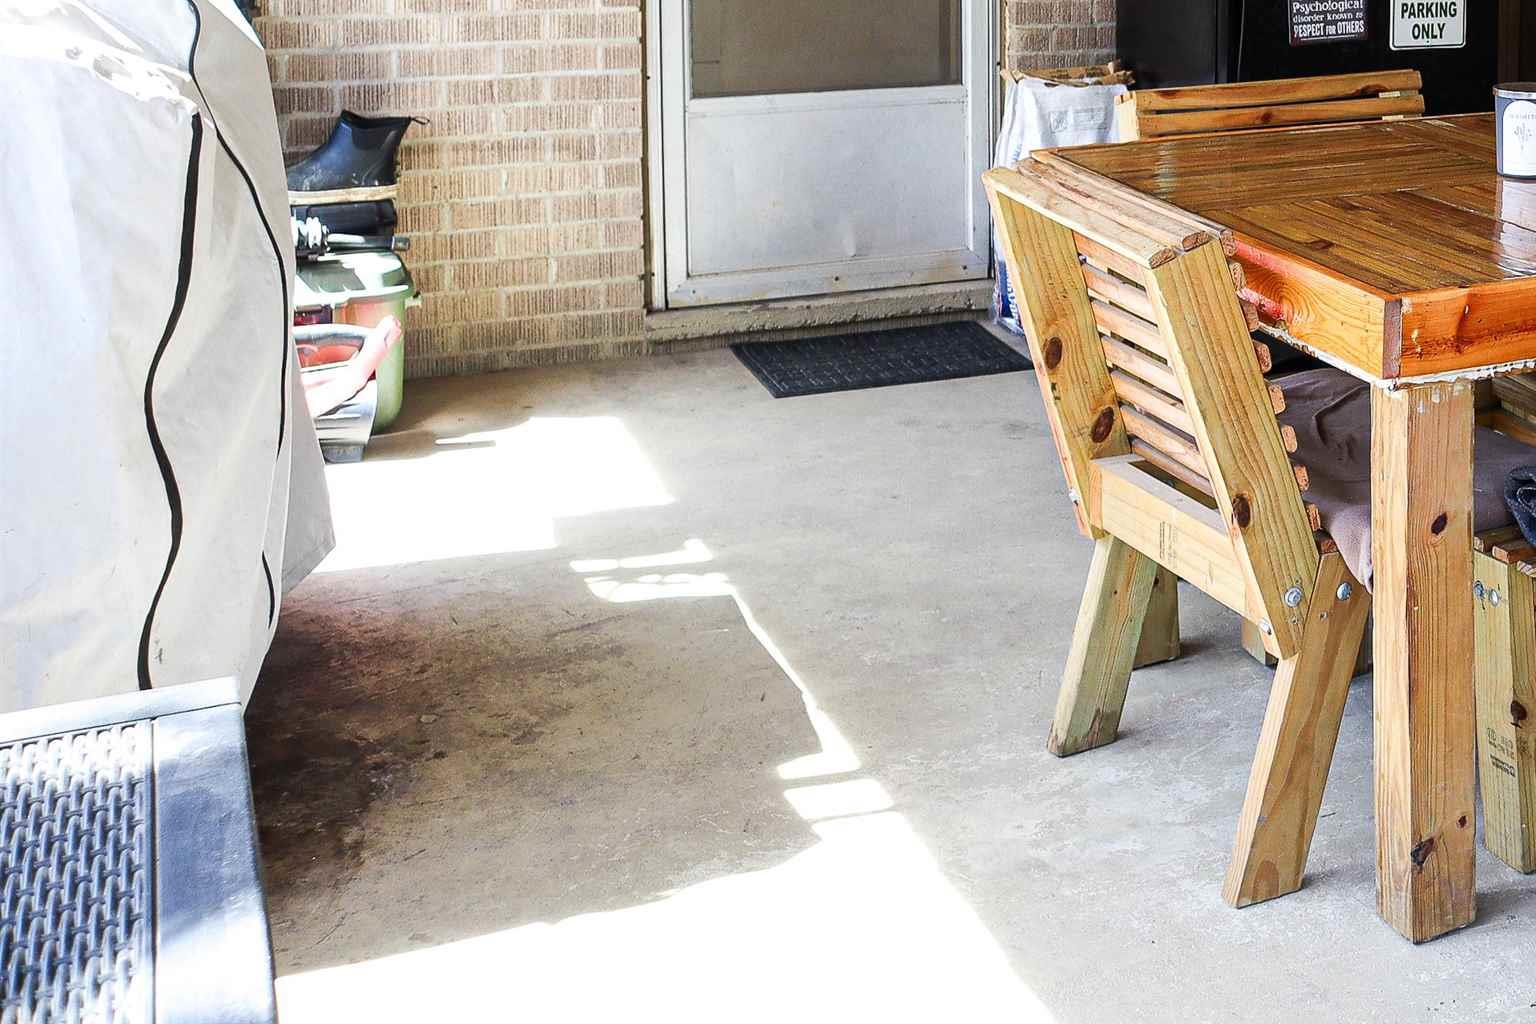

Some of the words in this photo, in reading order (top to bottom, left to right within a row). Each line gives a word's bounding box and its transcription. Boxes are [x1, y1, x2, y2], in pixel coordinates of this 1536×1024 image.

[1293, 14, 1325, 23] disorder
[1327, 12, 1353, 21] known
[1400, 1, 1458, 19] PARKING
[1293, 23, 1325, 38] RESPECT
[1337, 20, 1365, 34] OTHERS
[1412, 23, 1446, 40] ONLY
